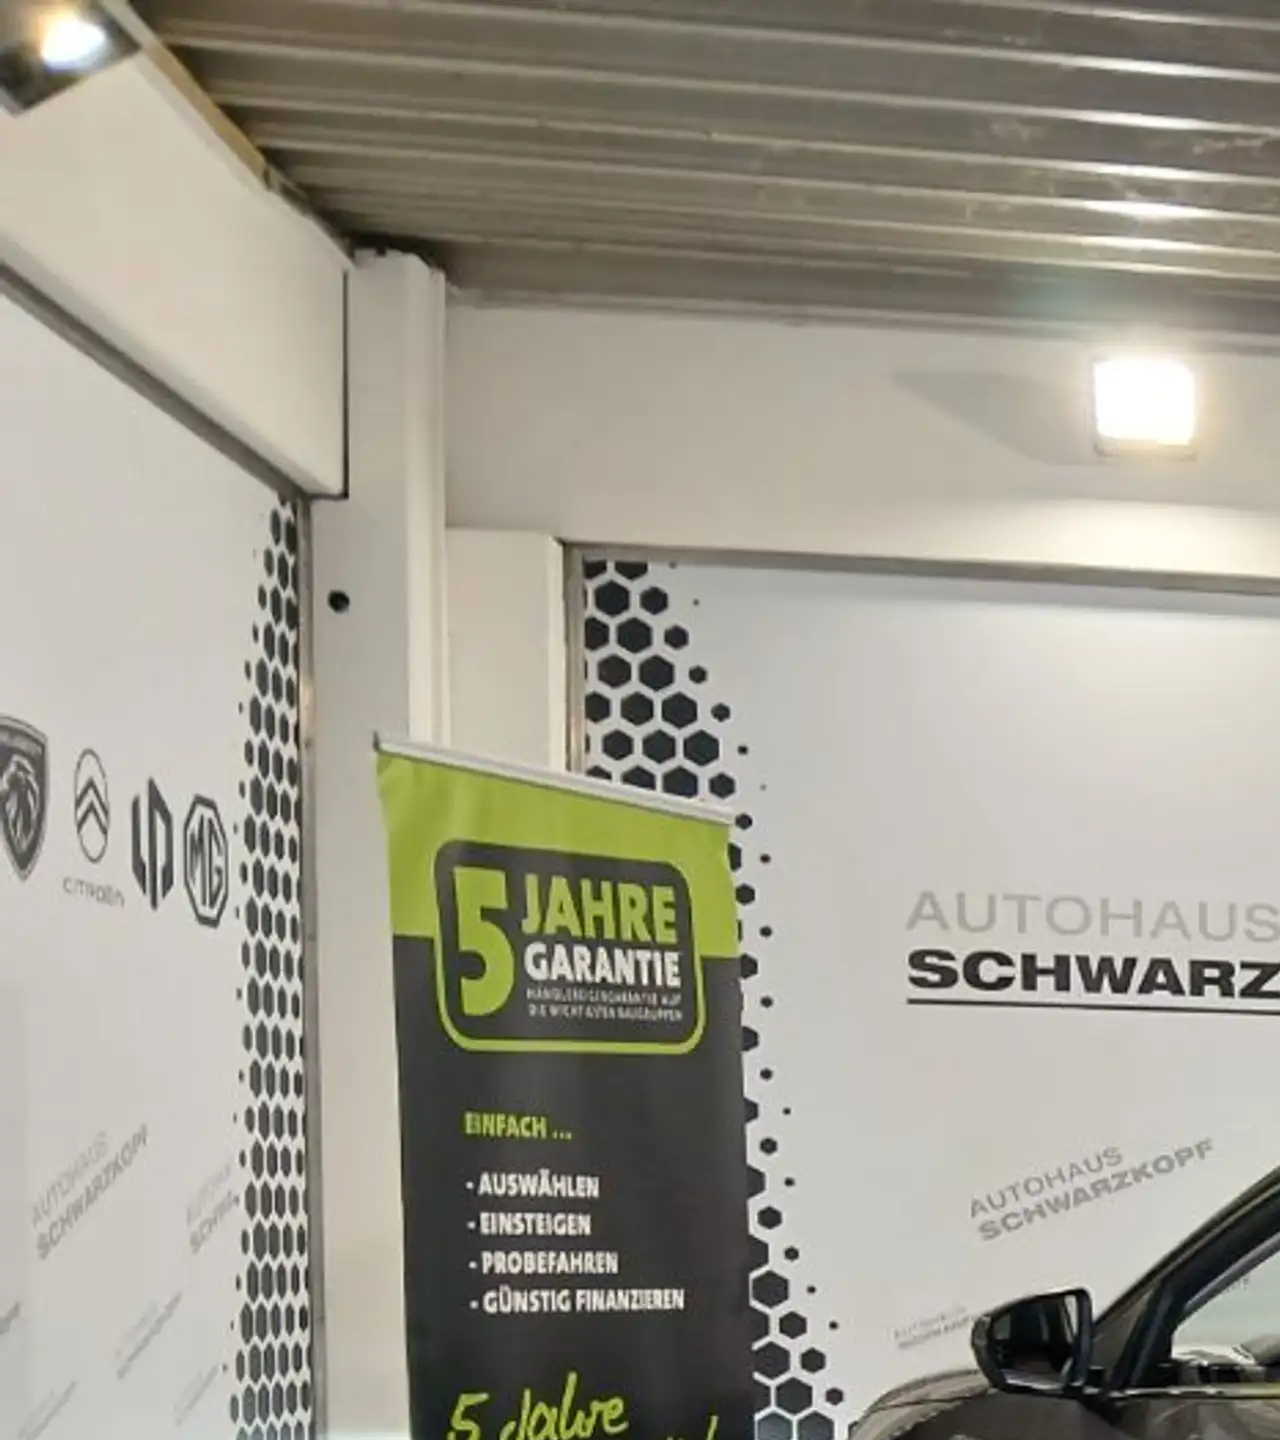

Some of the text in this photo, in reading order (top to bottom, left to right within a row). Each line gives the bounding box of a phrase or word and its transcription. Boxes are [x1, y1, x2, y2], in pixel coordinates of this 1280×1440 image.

[454, 866, 677, 1016] 5 JAHRE
[524, 943, 682, 988] GARANTIE
[465, 1111, 548, 1139] EINFACH
[477, 1168, 600, 1198] AUSWÄHLEN
[970, 1145, 1124, 1219] AUTOHAUS
[978, 1137, 1214, 1241] SCHWARZKOPF
[479, 1212, 592, 1237] EINSTEIGEN
[481, 1251, 619, 1276] PROBEFAHREN
[483, 1284, 685, 1314] GÜNSTIG FINANZIEREN
